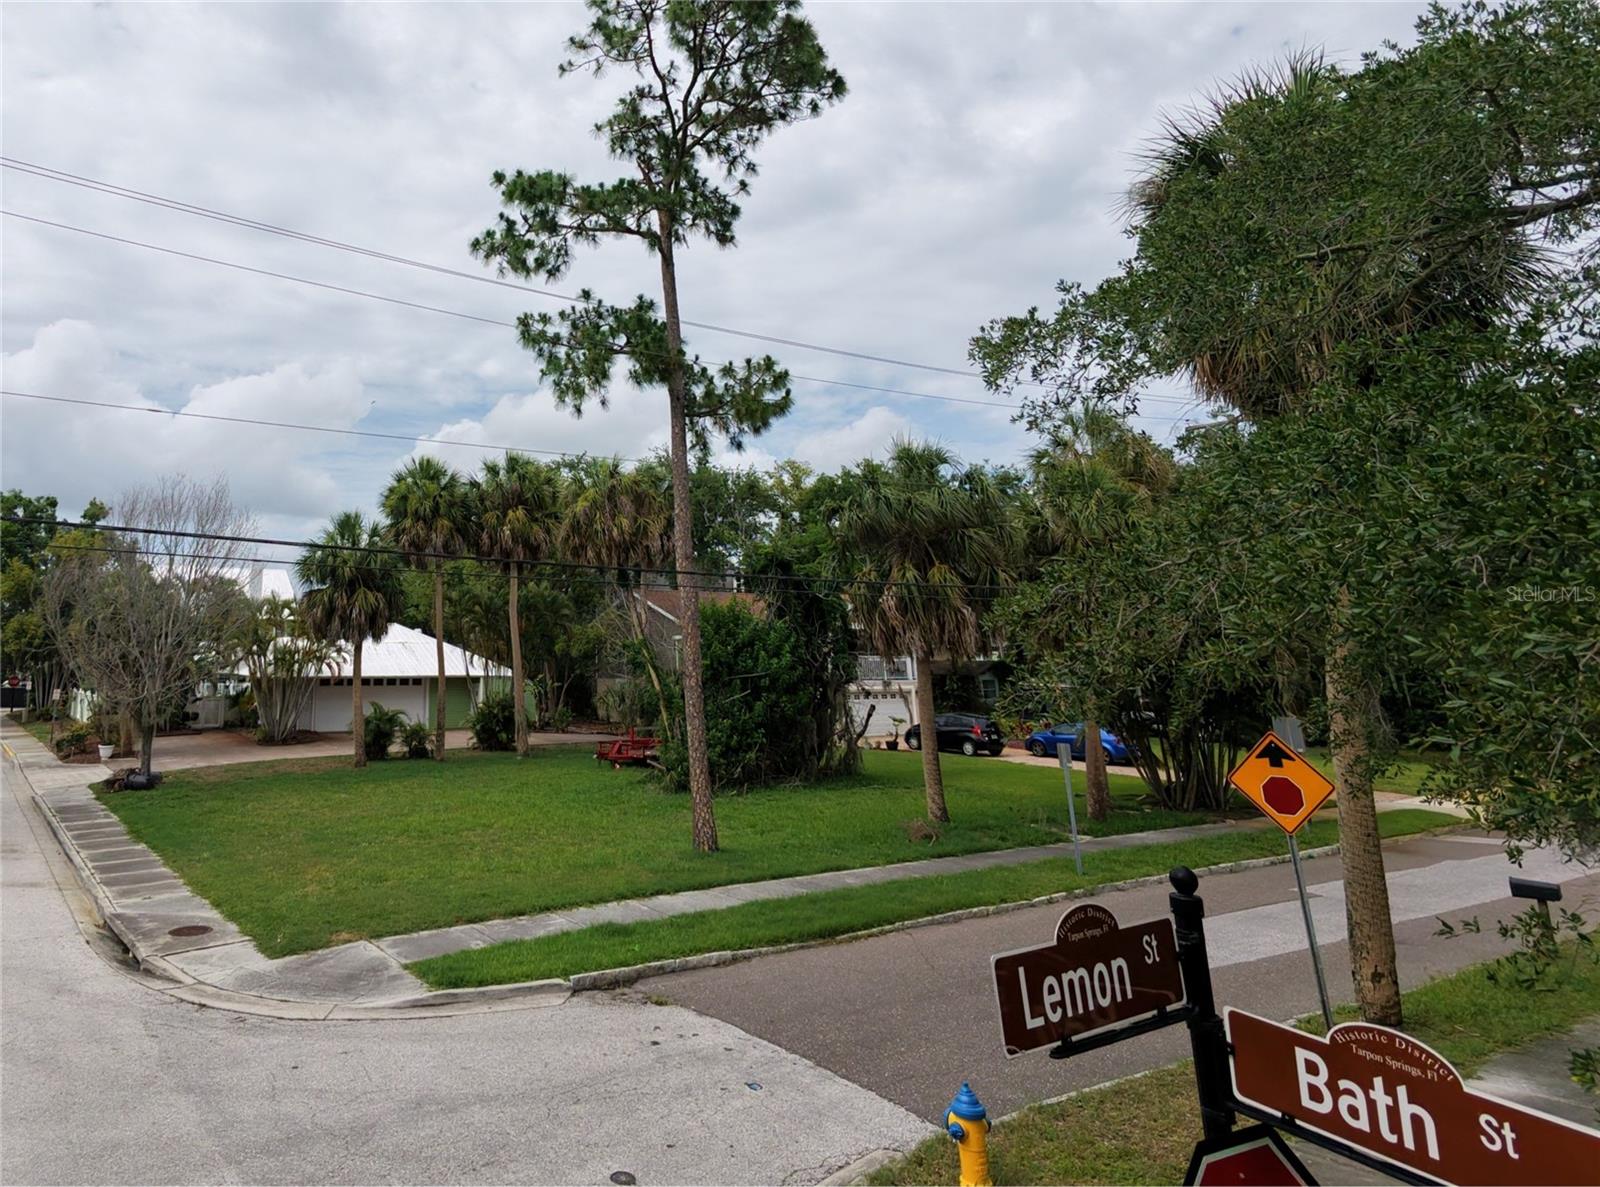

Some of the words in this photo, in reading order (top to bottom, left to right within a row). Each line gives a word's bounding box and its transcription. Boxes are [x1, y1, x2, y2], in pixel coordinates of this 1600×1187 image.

[1058, 911, 1086, 939] Historic
[1087, 907, 1115, 928] District
[1017, 956, 1133, 1030] Lemon
[1142, 933, 1160, 965] St
[1333, 1030, 1388, 1044] Historic
[1395, 1038, 1455, 1082] District
[1350, 1043, 1384, 1063] Tarpon
[1385, 1056, 1425, 1078] Springs,
[1294, 1046, 1440, 1161] Bath
[1478, 1113, 1520, 1160] St
